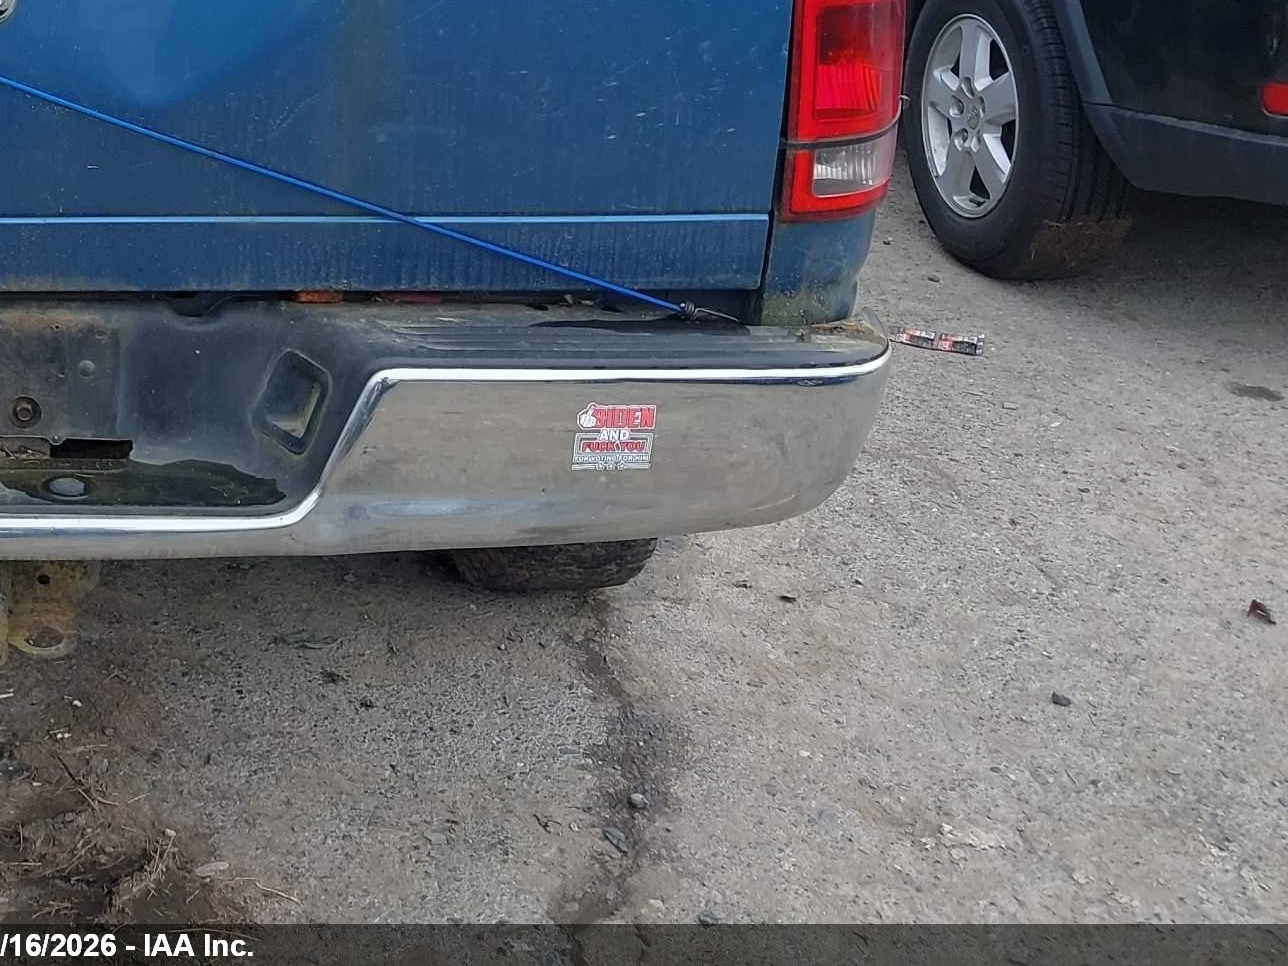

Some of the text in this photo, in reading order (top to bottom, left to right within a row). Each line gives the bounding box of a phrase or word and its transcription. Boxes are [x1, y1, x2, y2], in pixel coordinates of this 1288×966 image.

[599, 429, 630, 441] AND
[582, 441, 646, 452] FUCK YOU
